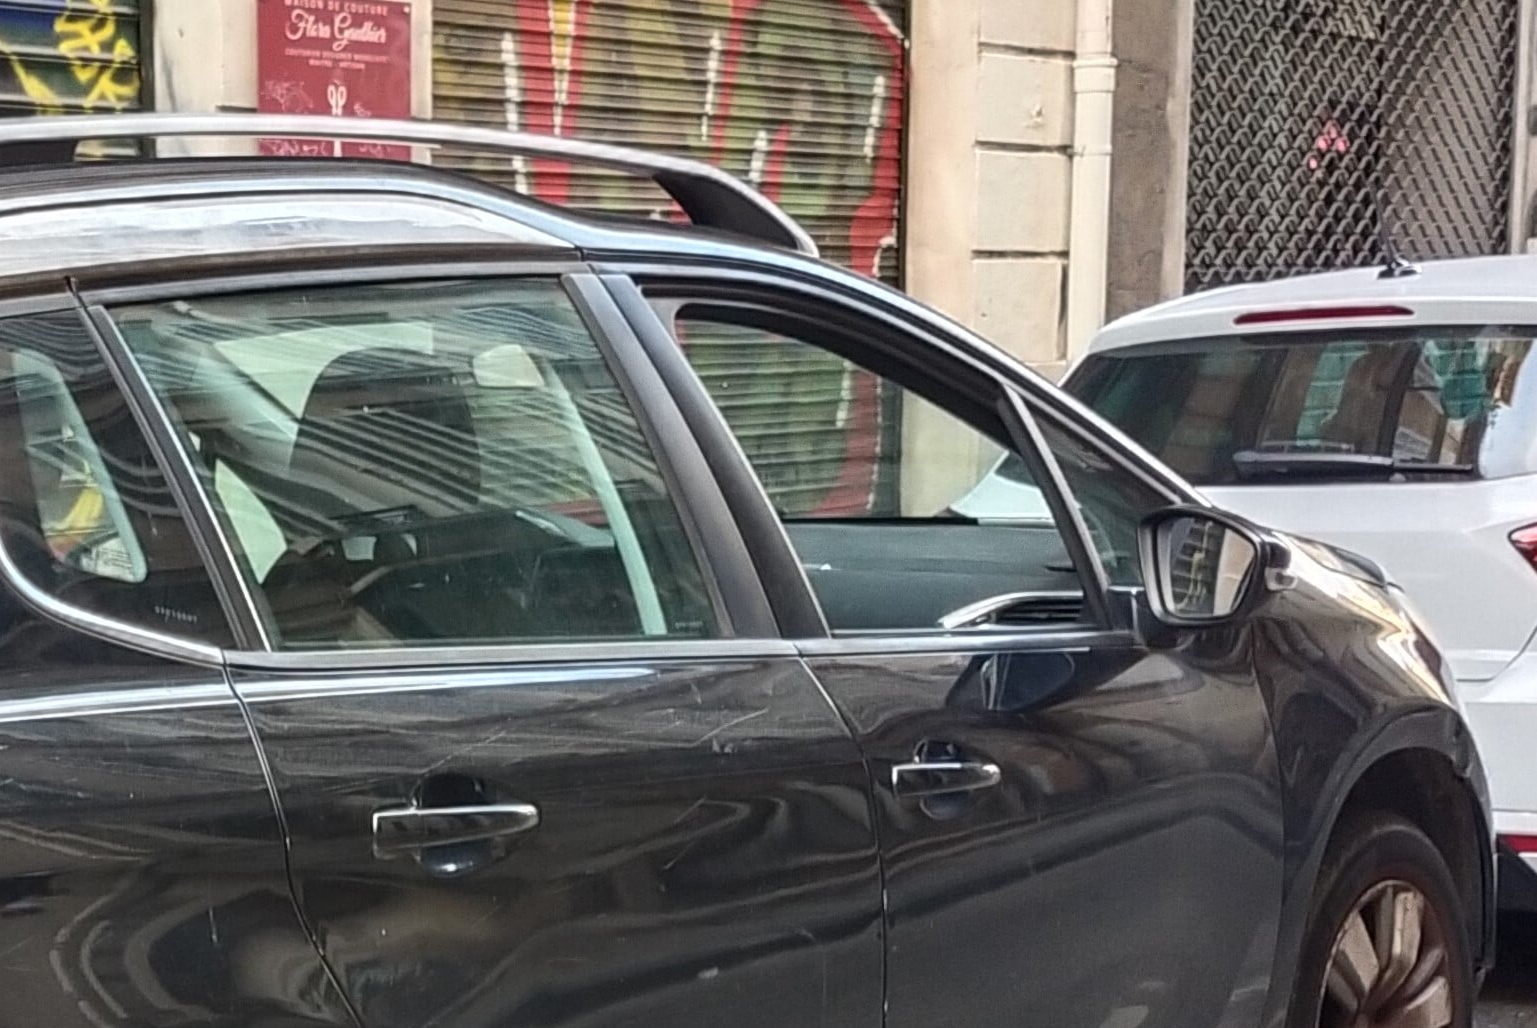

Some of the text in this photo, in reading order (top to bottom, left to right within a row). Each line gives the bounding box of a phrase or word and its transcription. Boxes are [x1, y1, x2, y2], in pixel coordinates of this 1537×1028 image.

[327, 1, 340, 11] DE
[343, 2, 388, 16] COUTURE
[285, 9, 331, 40] Flora
